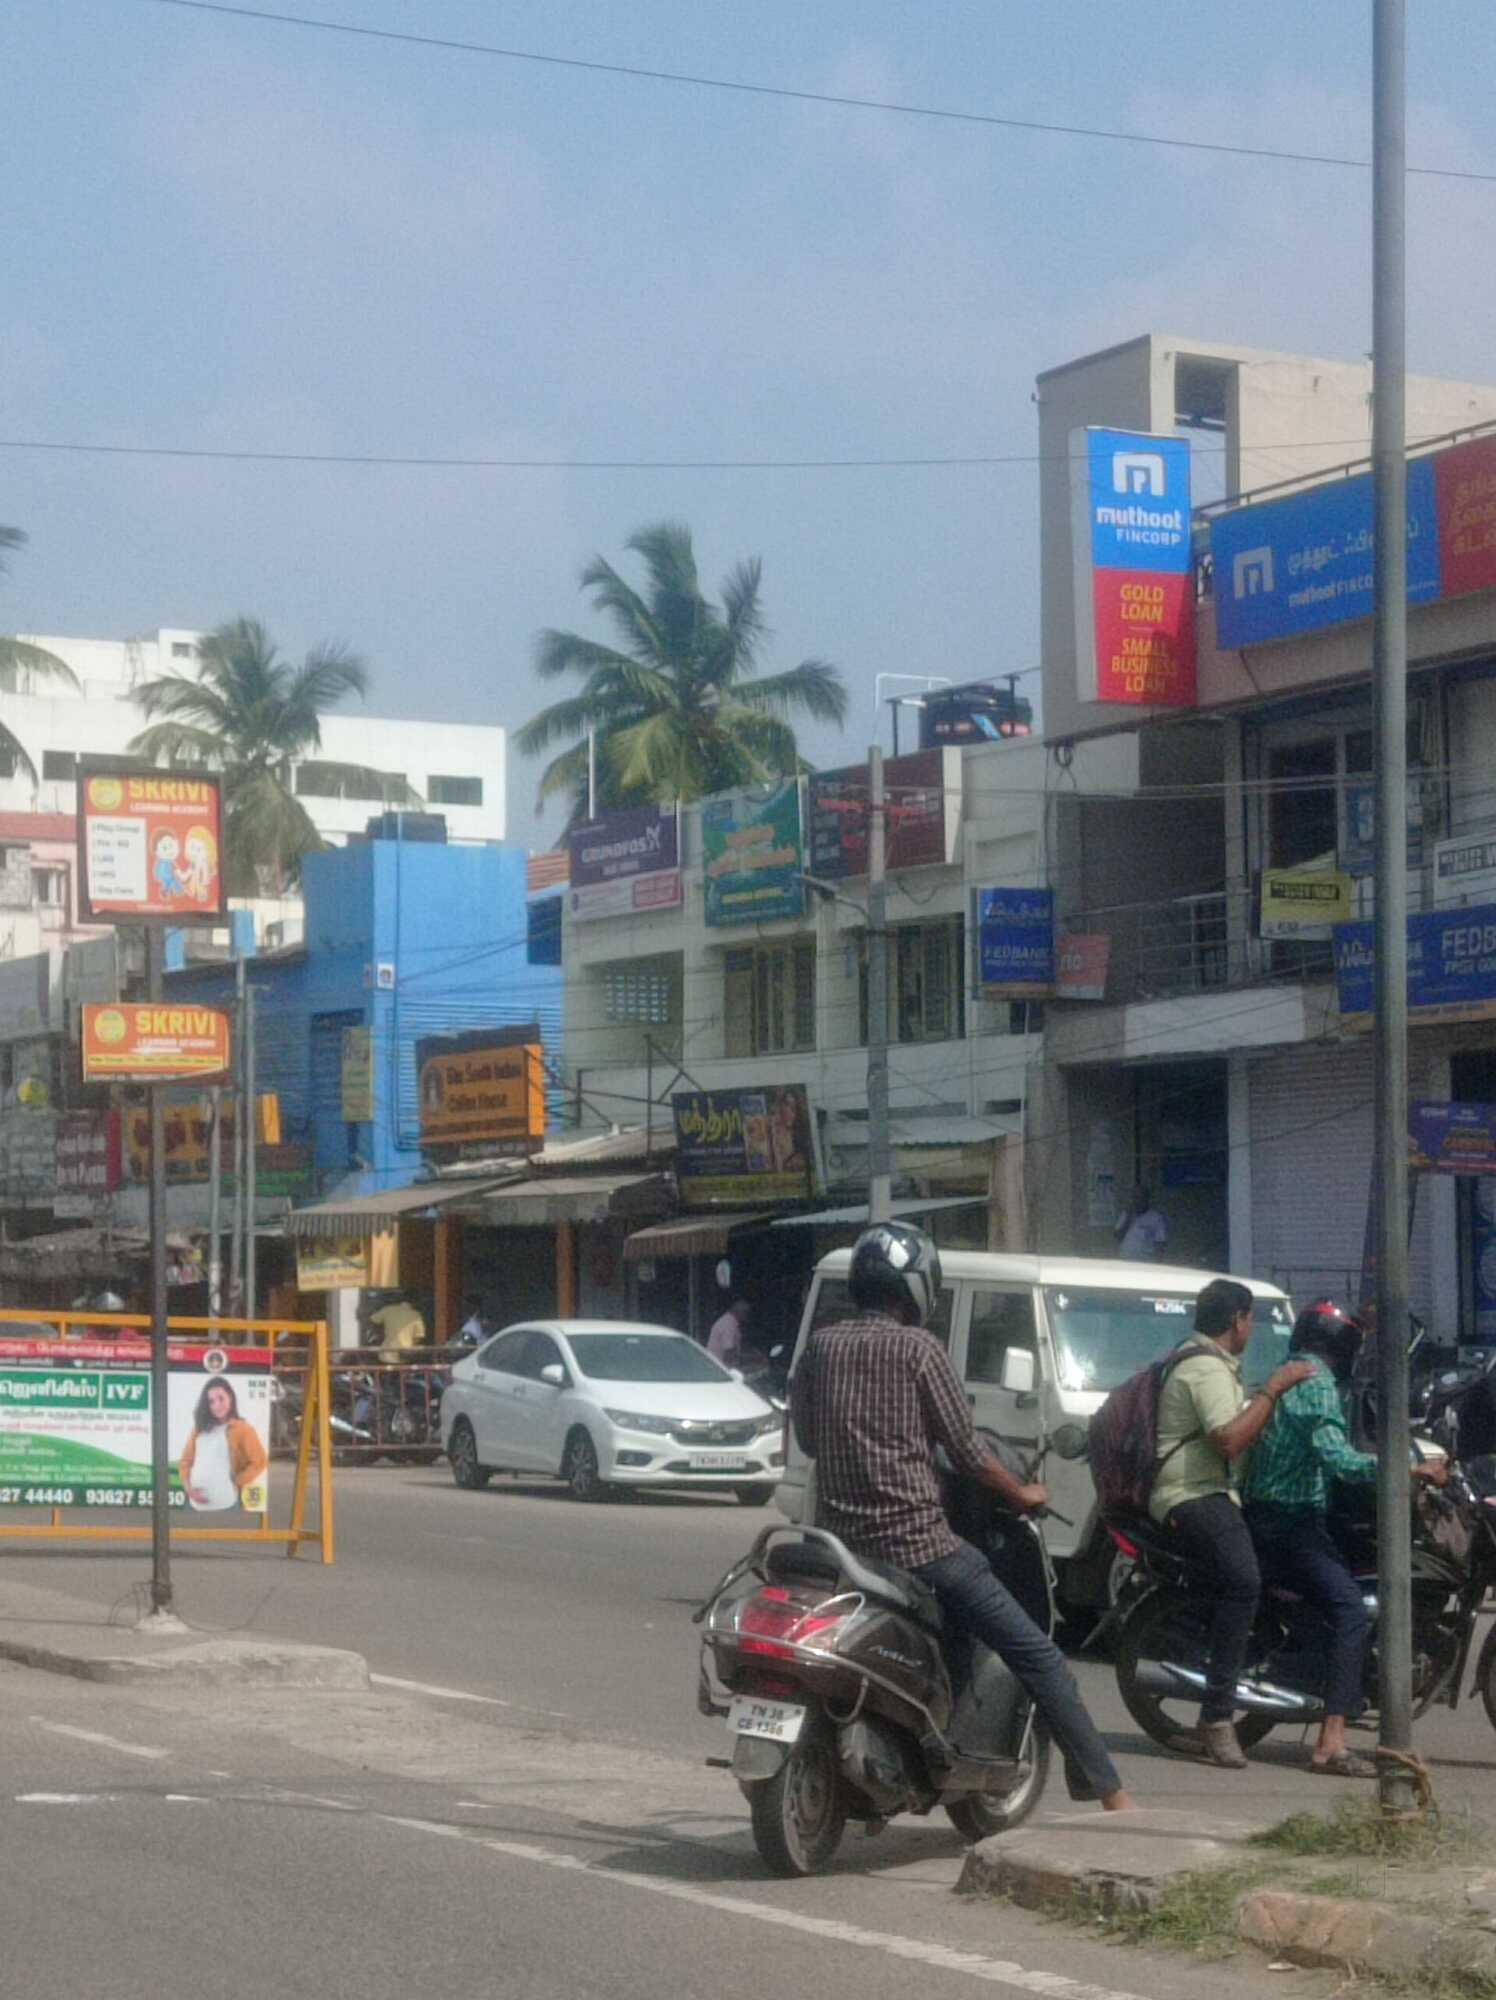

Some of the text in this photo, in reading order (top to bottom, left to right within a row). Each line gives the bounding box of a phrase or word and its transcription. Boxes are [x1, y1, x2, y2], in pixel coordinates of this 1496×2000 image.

[1096, 506, 1182, 531] muthoot
[1116, 529, 1182, 546] FINCORP
[1120, 583, 1164, 602] GOLD
[1120, 603, 1163, 623] LOAN
[1121, 637, 1169, 658] SMALL
[1111, 655, 1177, 675] BUSINESS
[1125, 675, 1166, 694] LOAN
[128, 778, 209, 801] SKRIVI
[136, 1010, 217, 1036] SKRIVI
[106, 1383, 145, 1401] IVF
[25, 1488, 74, 1503] 44440
[86, 1489, 134, 1504] 93627
